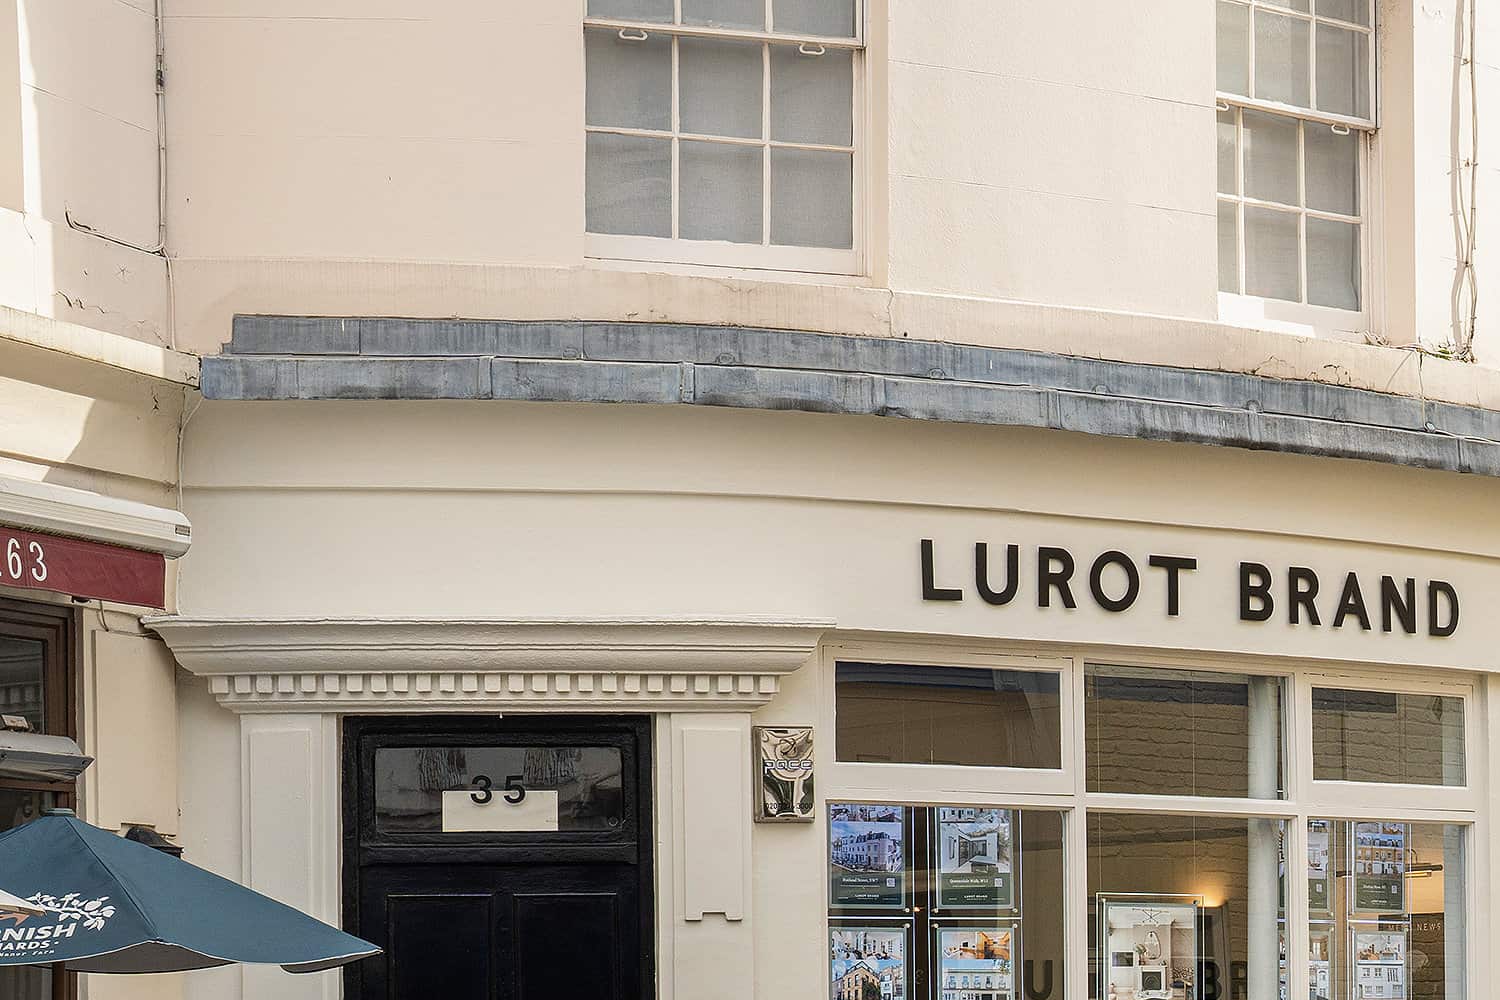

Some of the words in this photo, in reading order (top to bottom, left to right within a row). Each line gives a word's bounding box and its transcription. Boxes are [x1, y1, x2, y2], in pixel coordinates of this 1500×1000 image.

[0, 537, 48, 582] 63
[920, 538, 1197, 616] LUROT
[1239, 561, 1460, 637] BRAND
[470, 775, 526, 804] 35
[0, 922, 77, 941] NISH
